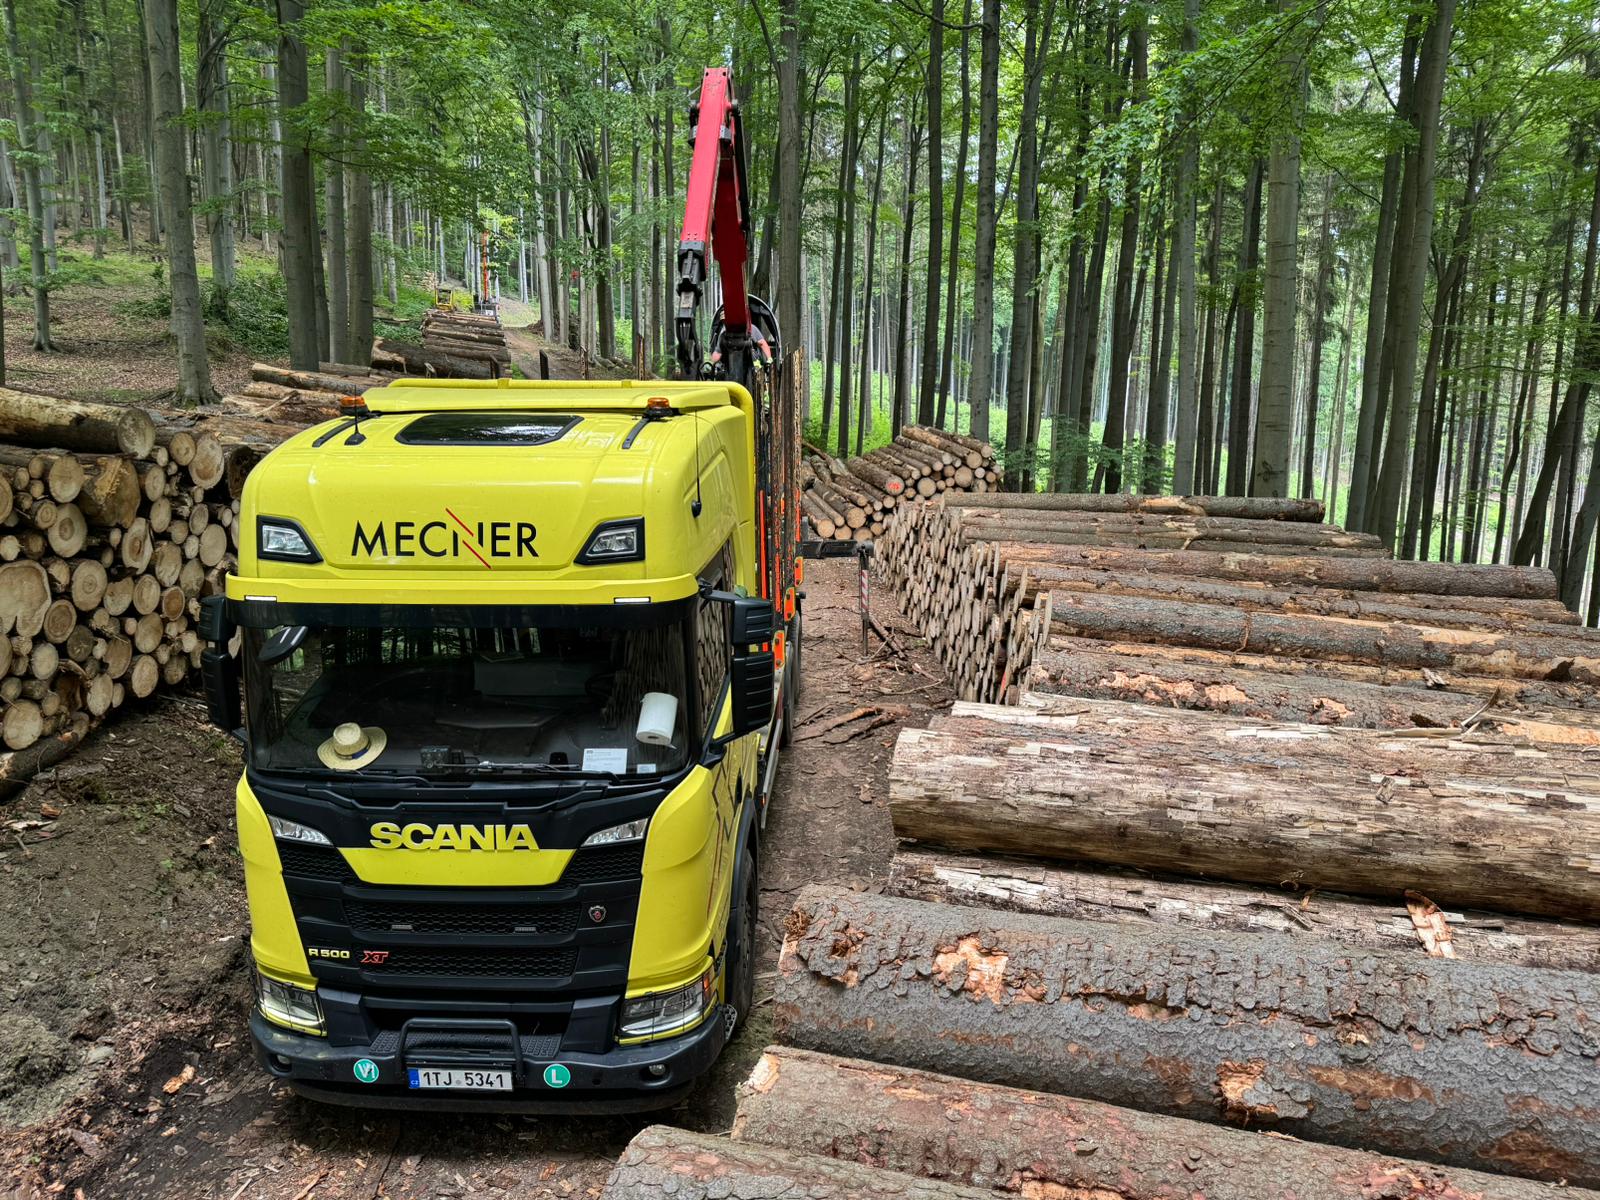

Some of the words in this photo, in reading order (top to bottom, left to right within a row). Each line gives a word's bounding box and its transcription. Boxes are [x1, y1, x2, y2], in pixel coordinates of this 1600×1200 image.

[351, 508, 539, 568] MECNER
[369, 822, 540, 851] SCANIA
[308, 948, 319, 957] R
[320, 949, 350, 959] 500
[360, 950, 389, 964] XT
[423, 1072, 452, 1087] 1TJ
[464, 1072, 504, 1088] 5341
[551, 1069, 562, 1084] L
